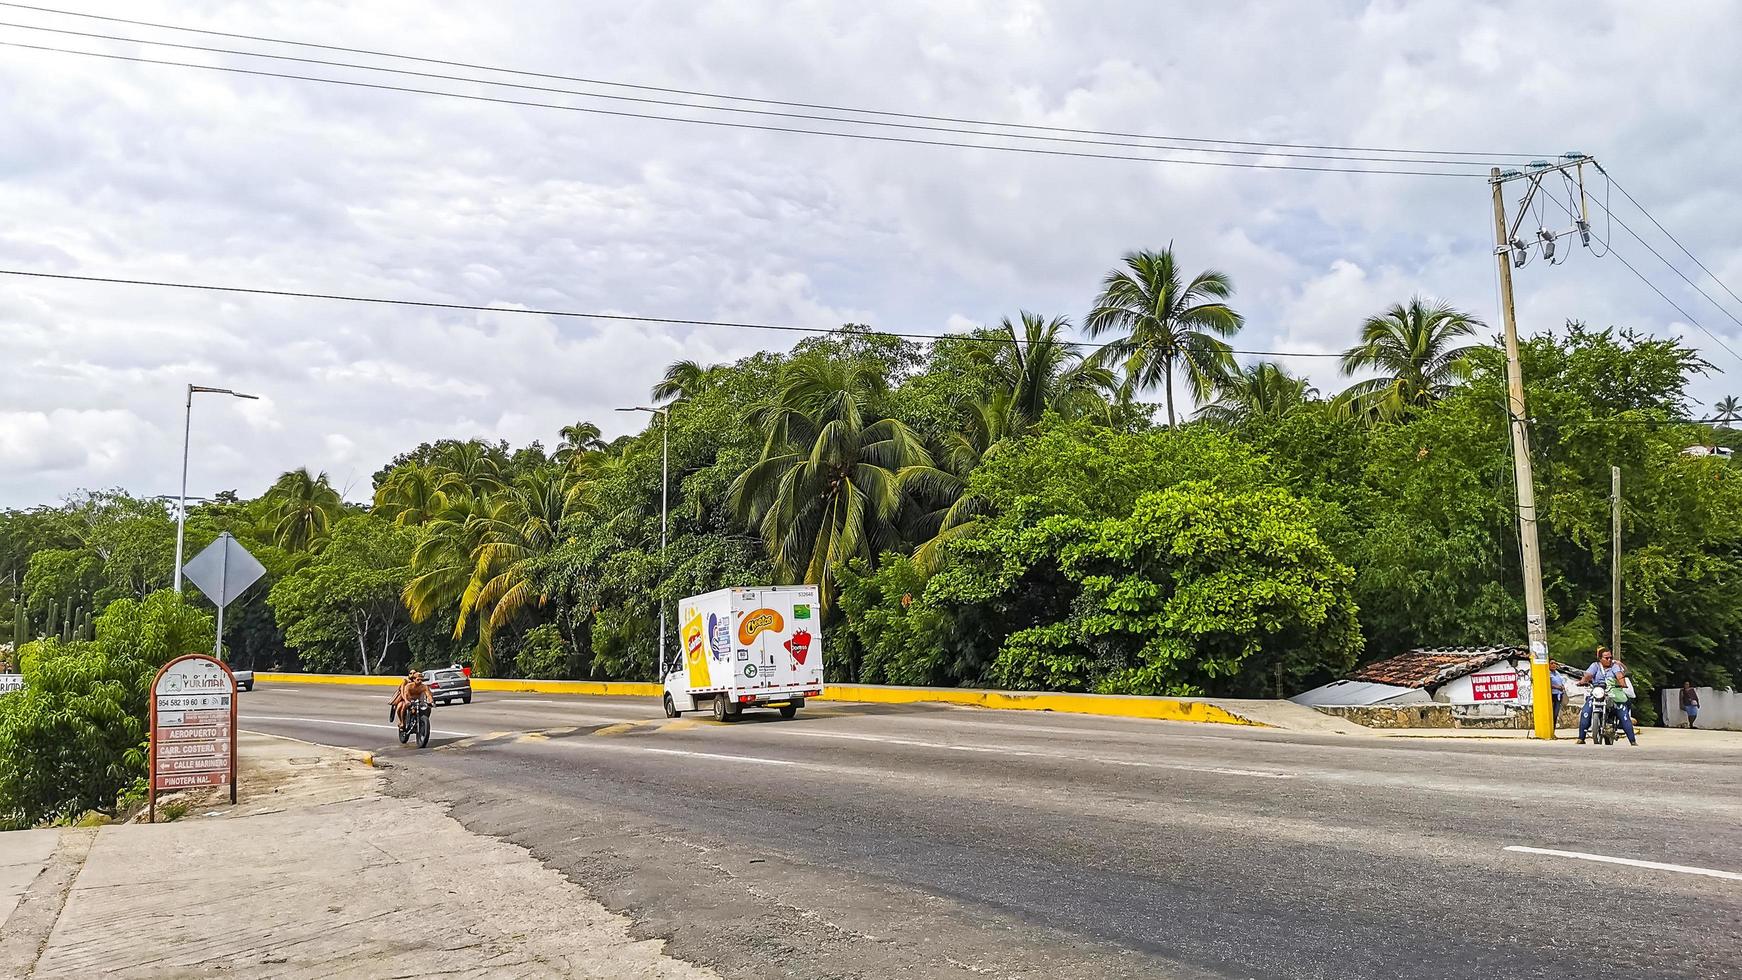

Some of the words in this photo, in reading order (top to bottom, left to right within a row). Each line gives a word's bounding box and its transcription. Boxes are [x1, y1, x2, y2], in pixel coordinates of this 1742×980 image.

[747, 615, 772, 634] Cheetos
[183, 679, 225, 688] YURIMAR
[1488, 683, 1514, 691] LIBERTAD
[183, 698, 190, 706] 19
[190, 698, 198, 706] 60
[169, 729, 217, 738] AEROPUERTO
[160, 746, 181, 755] CARR.
[182, 744, 215, 753] COSTERA
[174, 760, 194, 769] CALLE
[195, 759, 228, 768] MARINERO
[164, 777, 196, 786] PINOTEPA
[197, 775, 212, 784] NAL.
